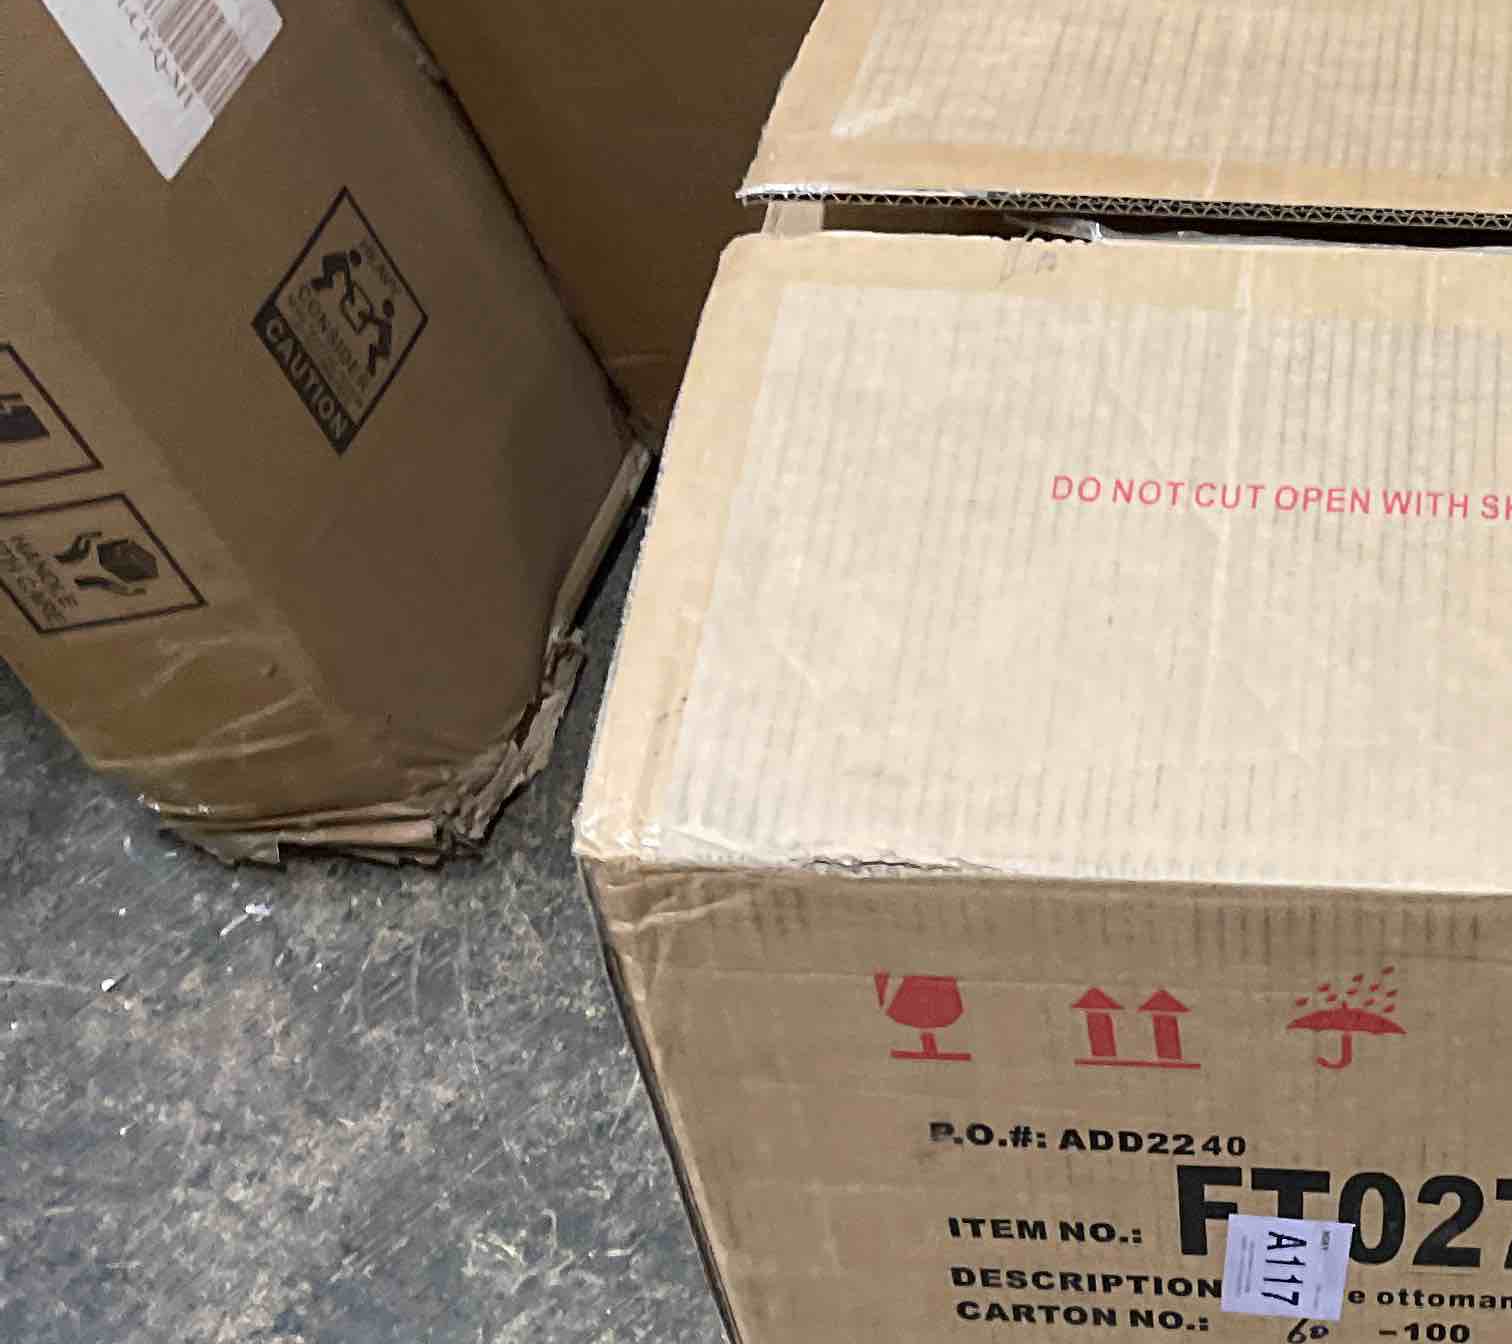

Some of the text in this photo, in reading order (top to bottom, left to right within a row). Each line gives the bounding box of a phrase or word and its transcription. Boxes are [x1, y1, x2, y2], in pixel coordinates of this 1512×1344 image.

[261, 311, 349, 442] CAUTION
[1050, 475, 1102, 503] DO
[1112, 479, 1185, 507] NOT
[1194, 482, 1266, 510] CUT
[1274, 485, 1371, 515] OPEN
[1382, 490, 1470, 520] WITH
[929, 1121, 1247, 1156] P.O.#: ADD2240
[948, 1216, 1048, 1240] ITEM
[1059, 1221, 1142, 1244] NO.:
[950, 1266, 1222, 1298] DESCRIPTION
[1260, 1230, 1309, 1306] A117
[956, 1301, 1118, 1328] CARTON
[1129, 1309, 1209, 1332] NO.:
[1378, 1323, 1471, 1344] -100
